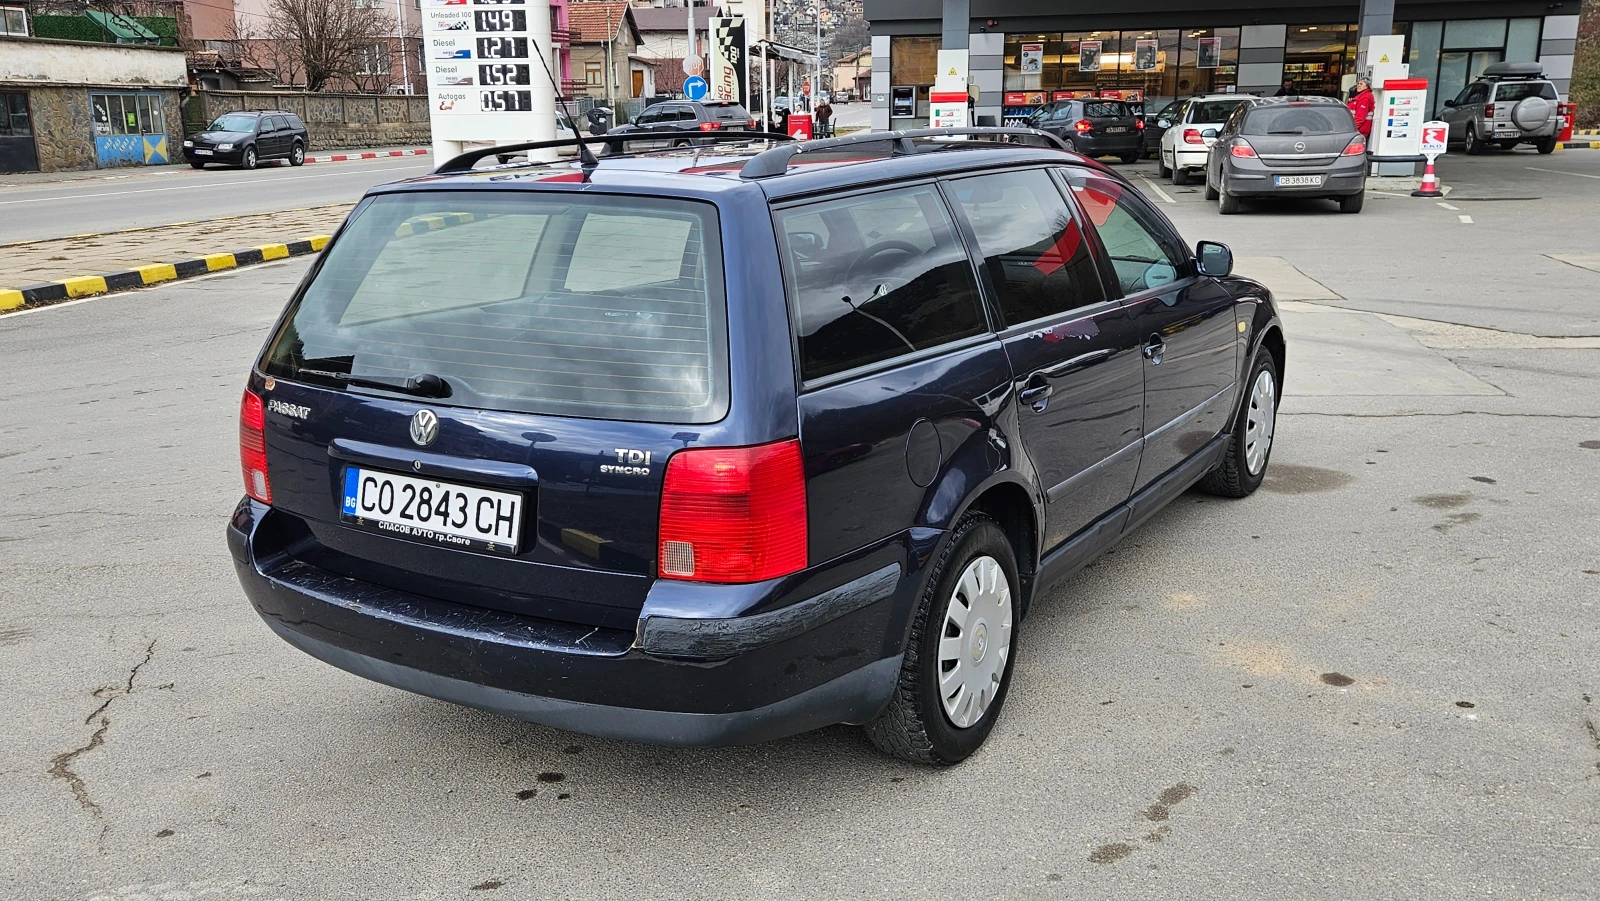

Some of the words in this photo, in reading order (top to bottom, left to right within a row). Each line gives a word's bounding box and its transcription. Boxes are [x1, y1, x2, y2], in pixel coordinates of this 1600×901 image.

[481, 10, 514, 31] 1.49
[484, 37, 516, 59] 1.27
[730, 46, 738, 64] 100
[486, 64, 517, 85] 1.52
[724, 66, 734, 101] acing
[438, 93, 466, 101] Autogas
[481, 90, 519, 111] 0.57
[1291, 176, 1309, 184] 3838
[268, 399, 311, 419] PASSAT
[615, 448, 651, 465] TDI
[600, 464, 650, 476] SYNCRO
[345, 496, 356, 509] BG
[361, 476, 394, 515] CO
[400, 483, 468, 529] 2843
[475, 496, 516, 539] CH
[378, 520, 411, 534] СПАСОВ
[412, 527, 434, 539] АУТО
